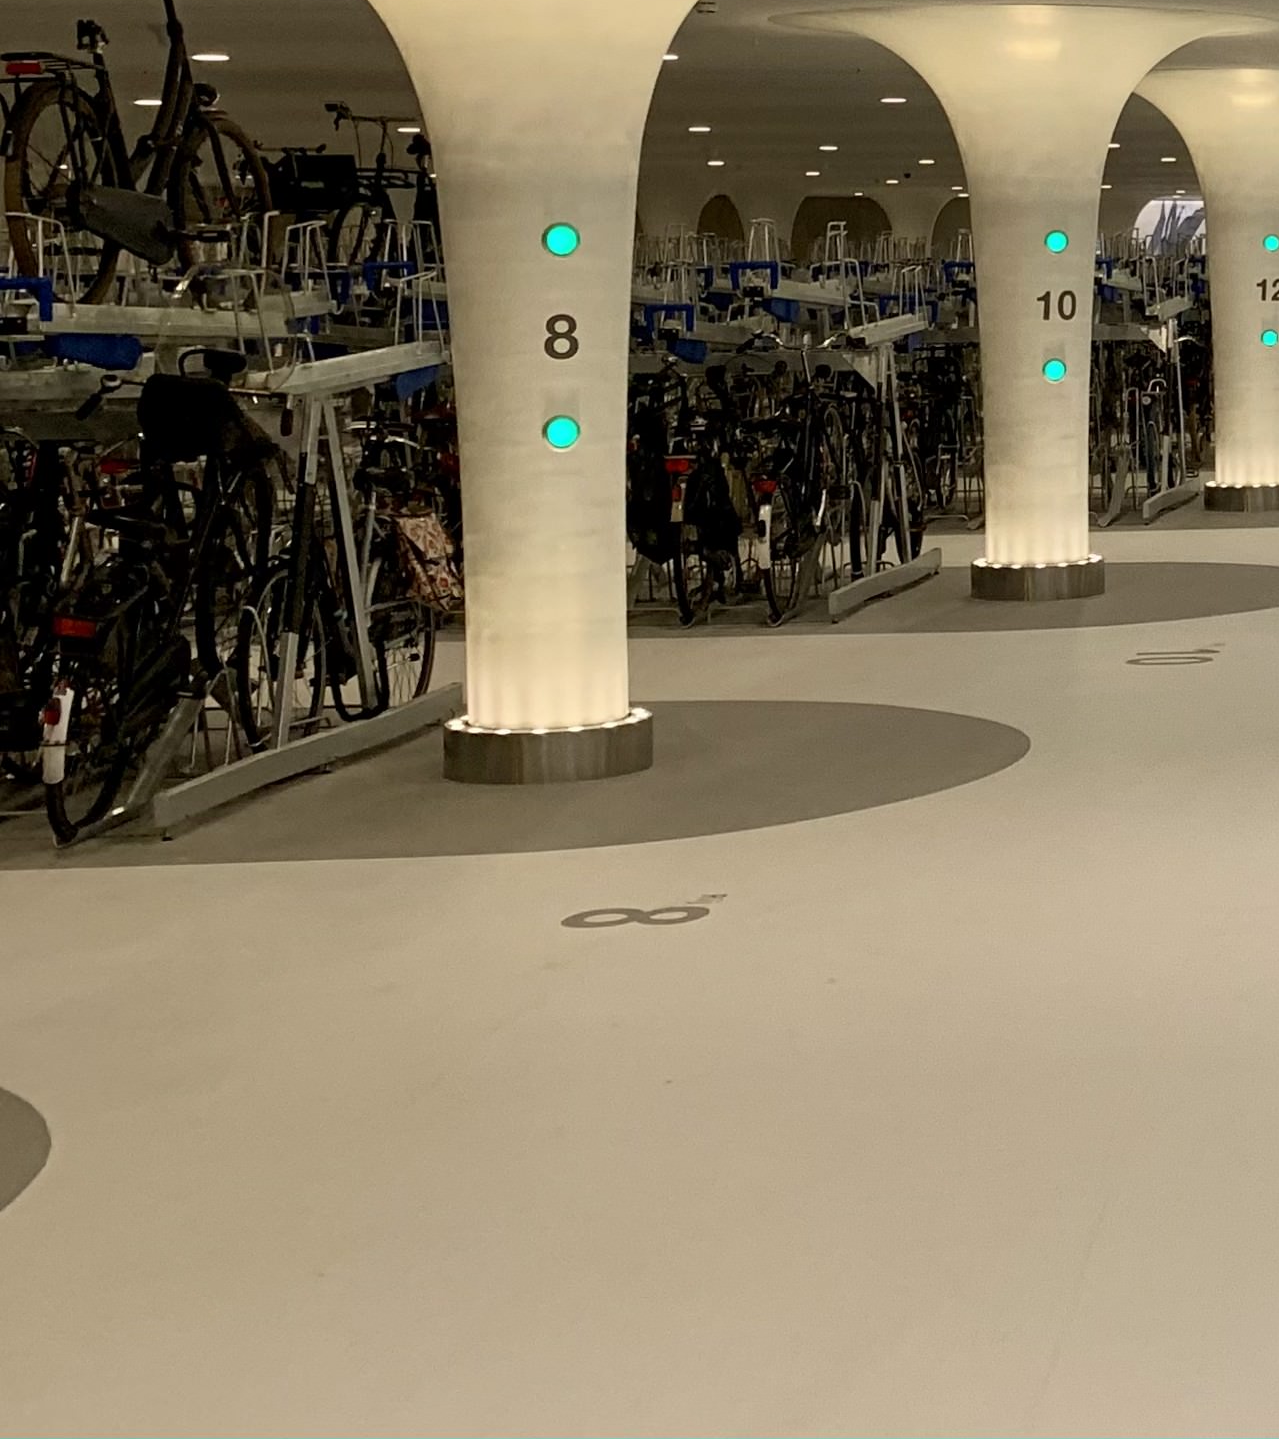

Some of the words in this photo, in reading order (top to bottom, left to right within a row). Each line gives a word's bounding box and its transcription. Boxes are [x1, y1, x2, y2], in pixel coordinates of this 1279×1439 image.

[1036, 290, 1077, 321] 10
[543, 314, 580, 360] 8
[560, 906, 710, 929] 8
